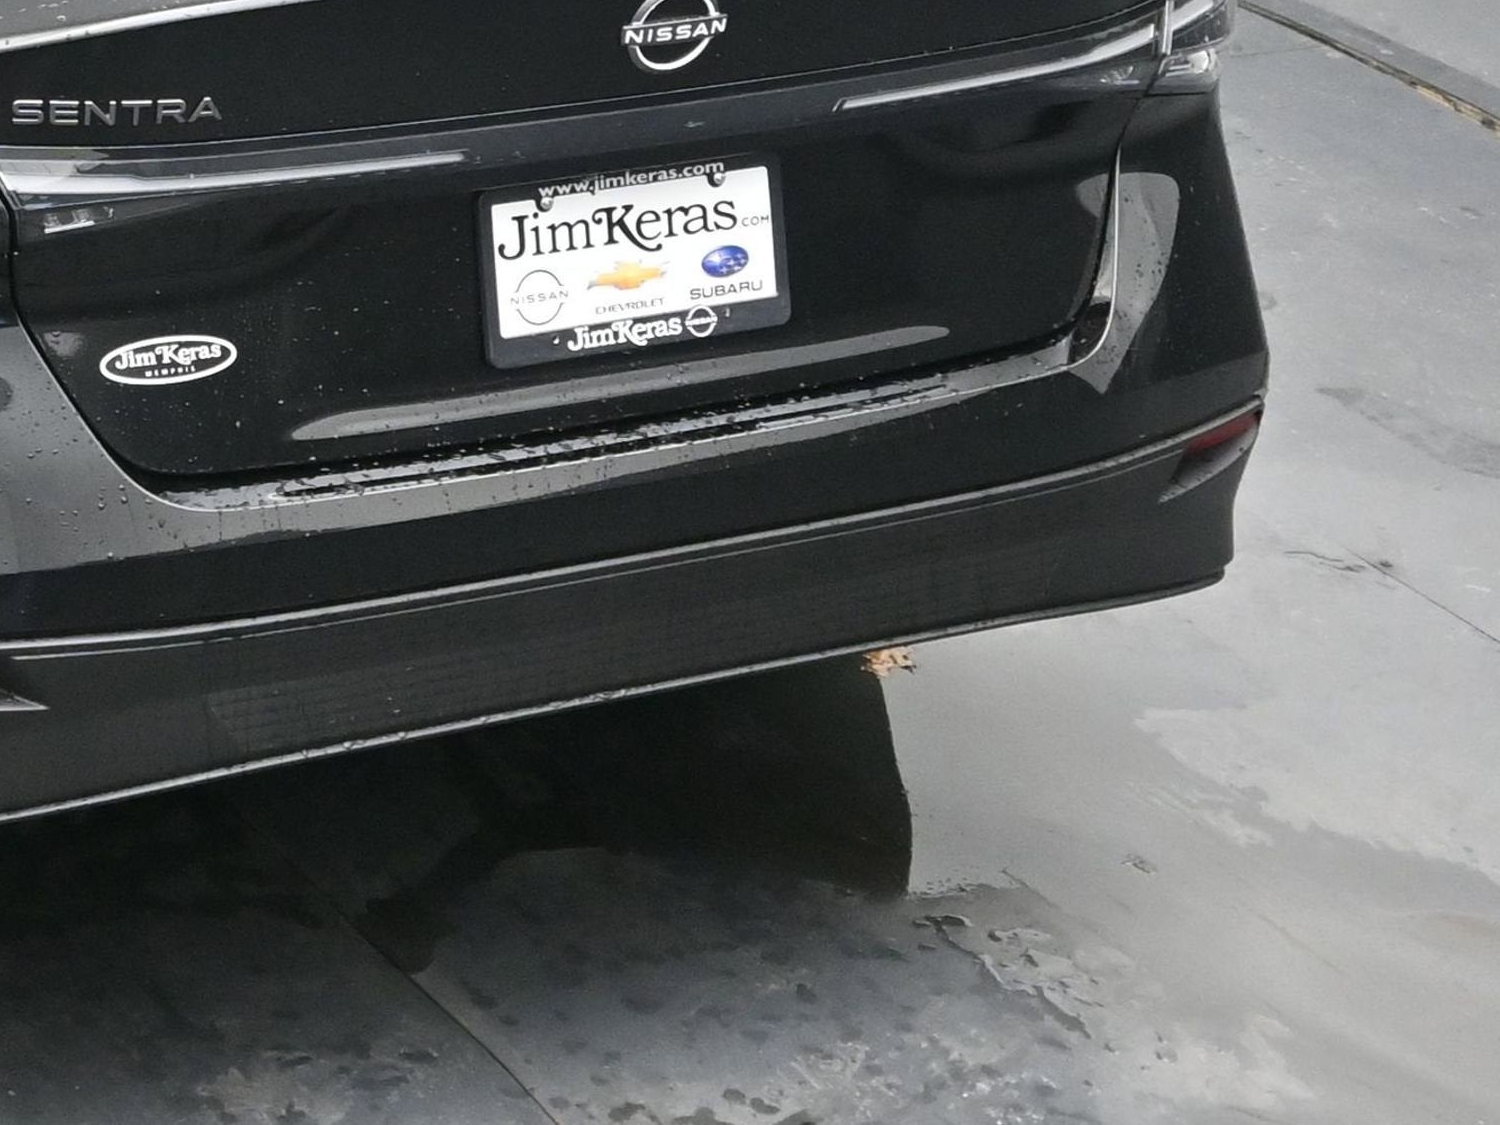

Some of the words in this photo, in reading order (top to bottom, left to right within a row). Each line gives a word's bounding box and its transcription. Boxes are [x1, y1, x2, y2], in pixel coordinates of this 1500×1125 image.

[624, 17, 728, 44] NISSAN
[11, 96, 223, 126] SENTRA
[538, 162, 725, 197] www.jimkeras.com
[510, 290, 569, 305] NISSAN
[689, 279, 764, 301] SUBARU
[595, 296, 665, 315] CHEVROLET
